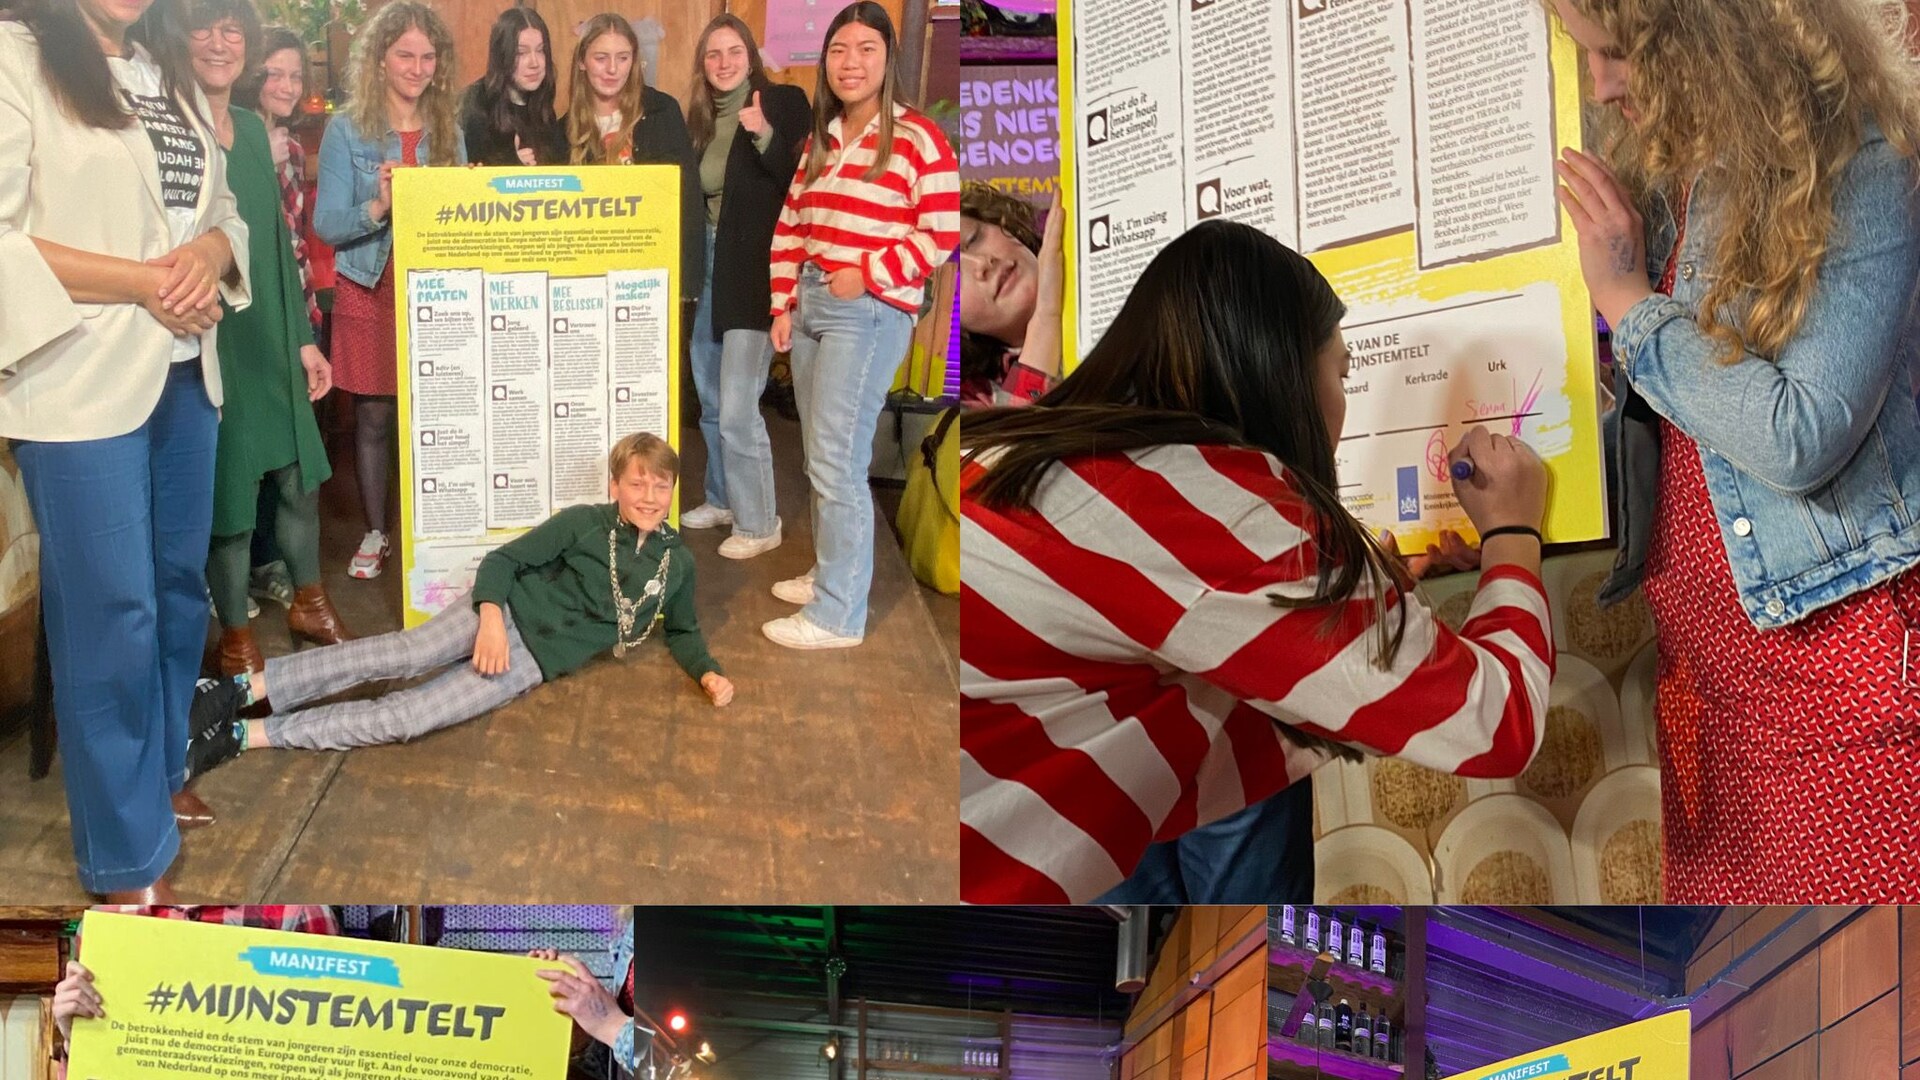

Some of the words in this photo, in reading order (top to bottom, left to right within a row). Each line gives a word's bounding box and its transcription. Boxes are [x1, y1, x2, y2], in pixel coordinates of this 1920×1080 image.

[1110, 100, 1125, 114] Just
[1128, 94, 1138, 108] do
[1140, 91, 1146, 104] it
[1110, 109, 1132, 129] (maar
[1135, 100, 1156, 118] houd
[1110, 127, 1123, 140] het
[1126, 114, 1157, 136] simpel)
[160, 170, 203, 186] LONDO
[506, 179, 564, 188] MANIFEST
[1223, 184, 1246, 199] Voor
[1248, 178, 1271, 192] wat,
[436, 196, 642, 226] #MIJNSTEMTELT
[1224, 197, 1251, 212] hoort
[1253, 191, 1272, 205] wat
[1112, 221, 1123, 234] Hi,
[1126, 215, 1141, 230] I'm
[1143, 209, 1166, 228] using
[1112, 225, 1155, 248] Whatsapp
[417, 278, 445, 289] MEE
[490, 281, 514, 295] MEE
[553, 286, 571, 298] MEE
[615, 279, 660, 291] Mogelijk
[417, 290, 467, 302] PRATEN
[490, 296, 538, 311] WERKEN
[554, 298, 603, 312] BESLISSEN
[616, 290, 650, 301] maken
[1356, 336, 1380, 351] VAN
[1384, 333, 1399, 346] DE
[1350, 344, 1430, 369] IJNSTEMTELT
[1488, 359, 1506, 372] Urk
[1405, 368, 1448, 385] Kerkrade
[270, 952, 371, 975] MANIFEST
[146, 981, 505, 1041] #MIJNSTEMTELT
[111, 1020, 124, 1030] De
[128, 1022, 203, 1039] betrokkenheid
[206, 1033, 219, 1041] en
[222, 1033, 235, 1043] de
[237, 1035, 262, 1046] stem
[266, 1039, 285, 1048] van
[287, 1040, 333, 1055] jongeren
[337, 1044, 354, 1058] zijn
[359, 1047, 411, 1062] essentieel
[415, 1054, 438, 1065] voor
[441, 1057, 467, 1068] onze
[470, 1059, 533, 1077] democratie,
[125, 1032, 148, 1046] juist
[152, 1037, 164, 1046] nu
[167, 1037, 180, 1048] de
[183, 1039, 240, 1055] democratie
[245, 1046, 254, 1056] in
[258, 1048, 294, 1062] Europa
[297, 1051, 327, 1063] onder
[330, 1056, 354, 1067] vuur
[357, 1058, 377, 1072] ligt.
[382, 1061, 403, 1072] Aan
[405, 1063, 418, 1074] de
[420, 1064, 477, 1080] vooravond
[116, 1043, 266, 1072] gemeenteraadsverkiezingen,
[270, 1061, 306, 1076] roepen
[308, 1064, 326, 1078] wij
[328, 1067, 342, 1077] als
[136, 1058, 154, 1067] van
[157, 1059, 211, 1074] Nederland
[214, 1067, 227, 1078] op
[231, 1069, 248, 1078] ons
